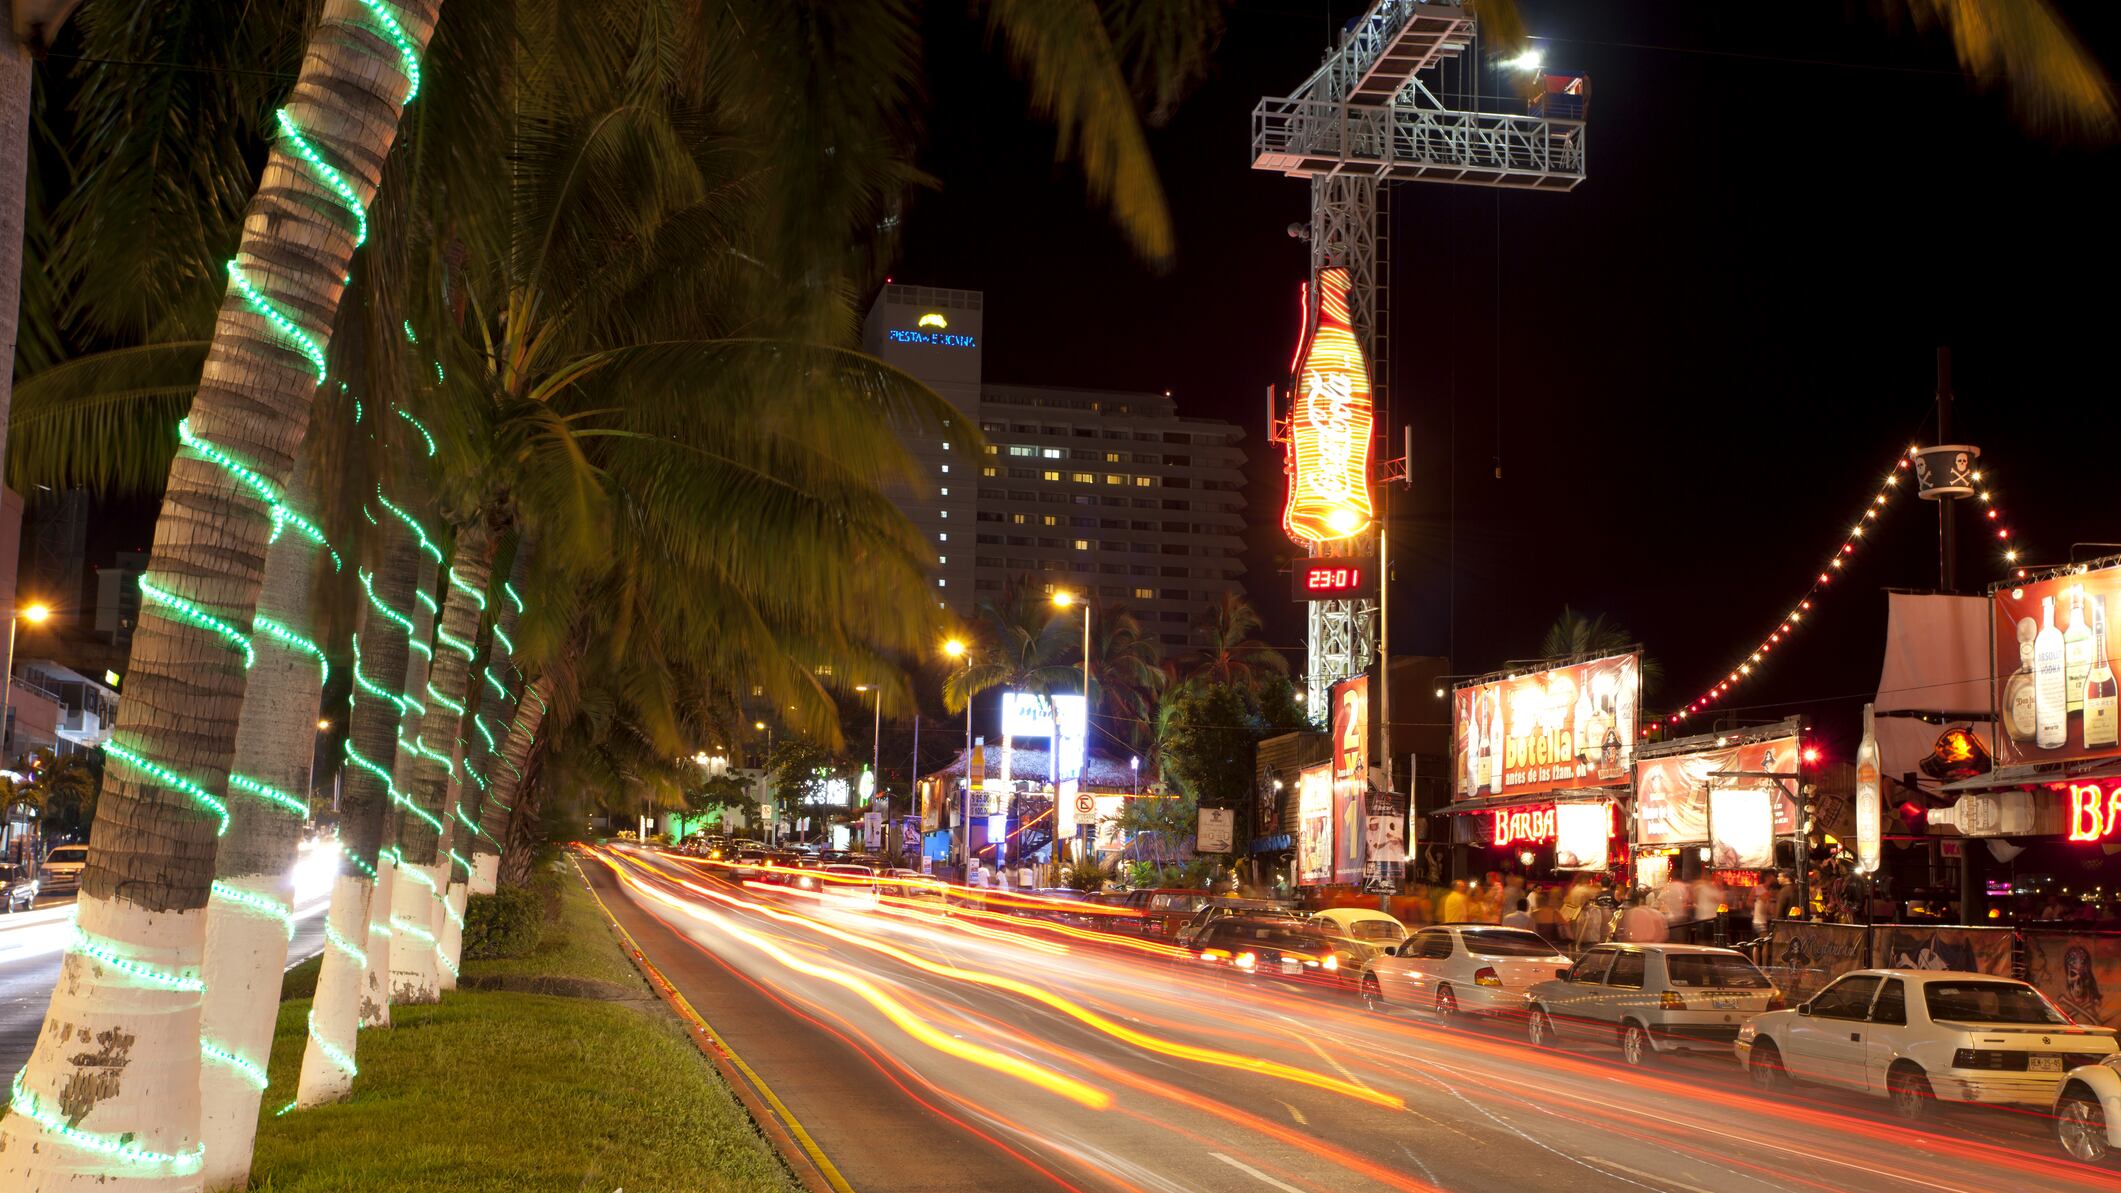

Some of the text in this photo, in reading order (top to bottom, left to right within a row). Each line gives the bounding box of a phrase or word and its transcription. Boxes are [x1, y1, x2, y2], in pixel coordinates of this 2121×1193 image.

[889, 330, 976, 347] FIESTAEICANA
[1309, 569, 1358, 588] 23:01
[1505, 727, 1573, 769] botella
[1505, 769, 1526, 786] antes
[1528, 768, 1537, 783] de
[1539, 766, 1550, 782] las
